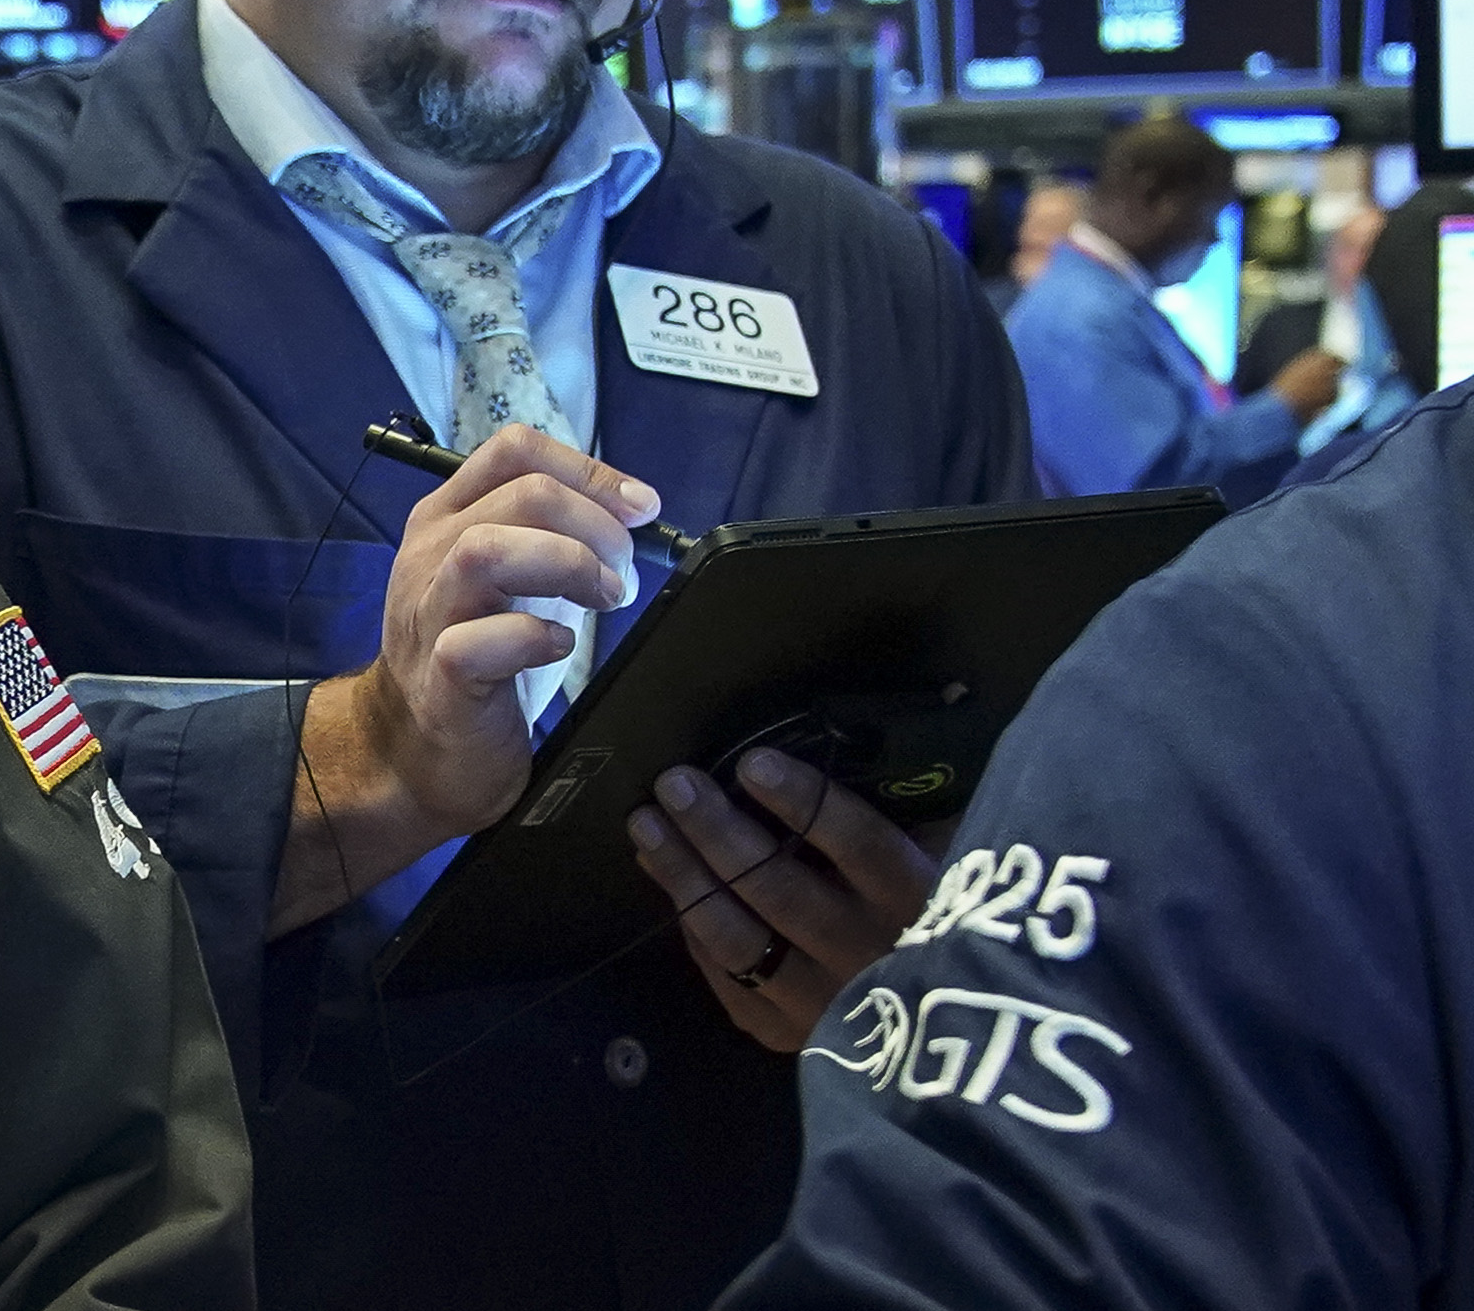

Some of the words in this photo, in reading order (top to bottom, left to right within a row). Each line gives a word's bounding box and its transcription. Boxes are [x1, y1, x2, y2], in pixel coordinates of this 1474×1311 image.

[653, 284, 762, 339] 286
[650, 330, 707, 352] MICHAEL
[900, 987, 1134, 1134] GTS
